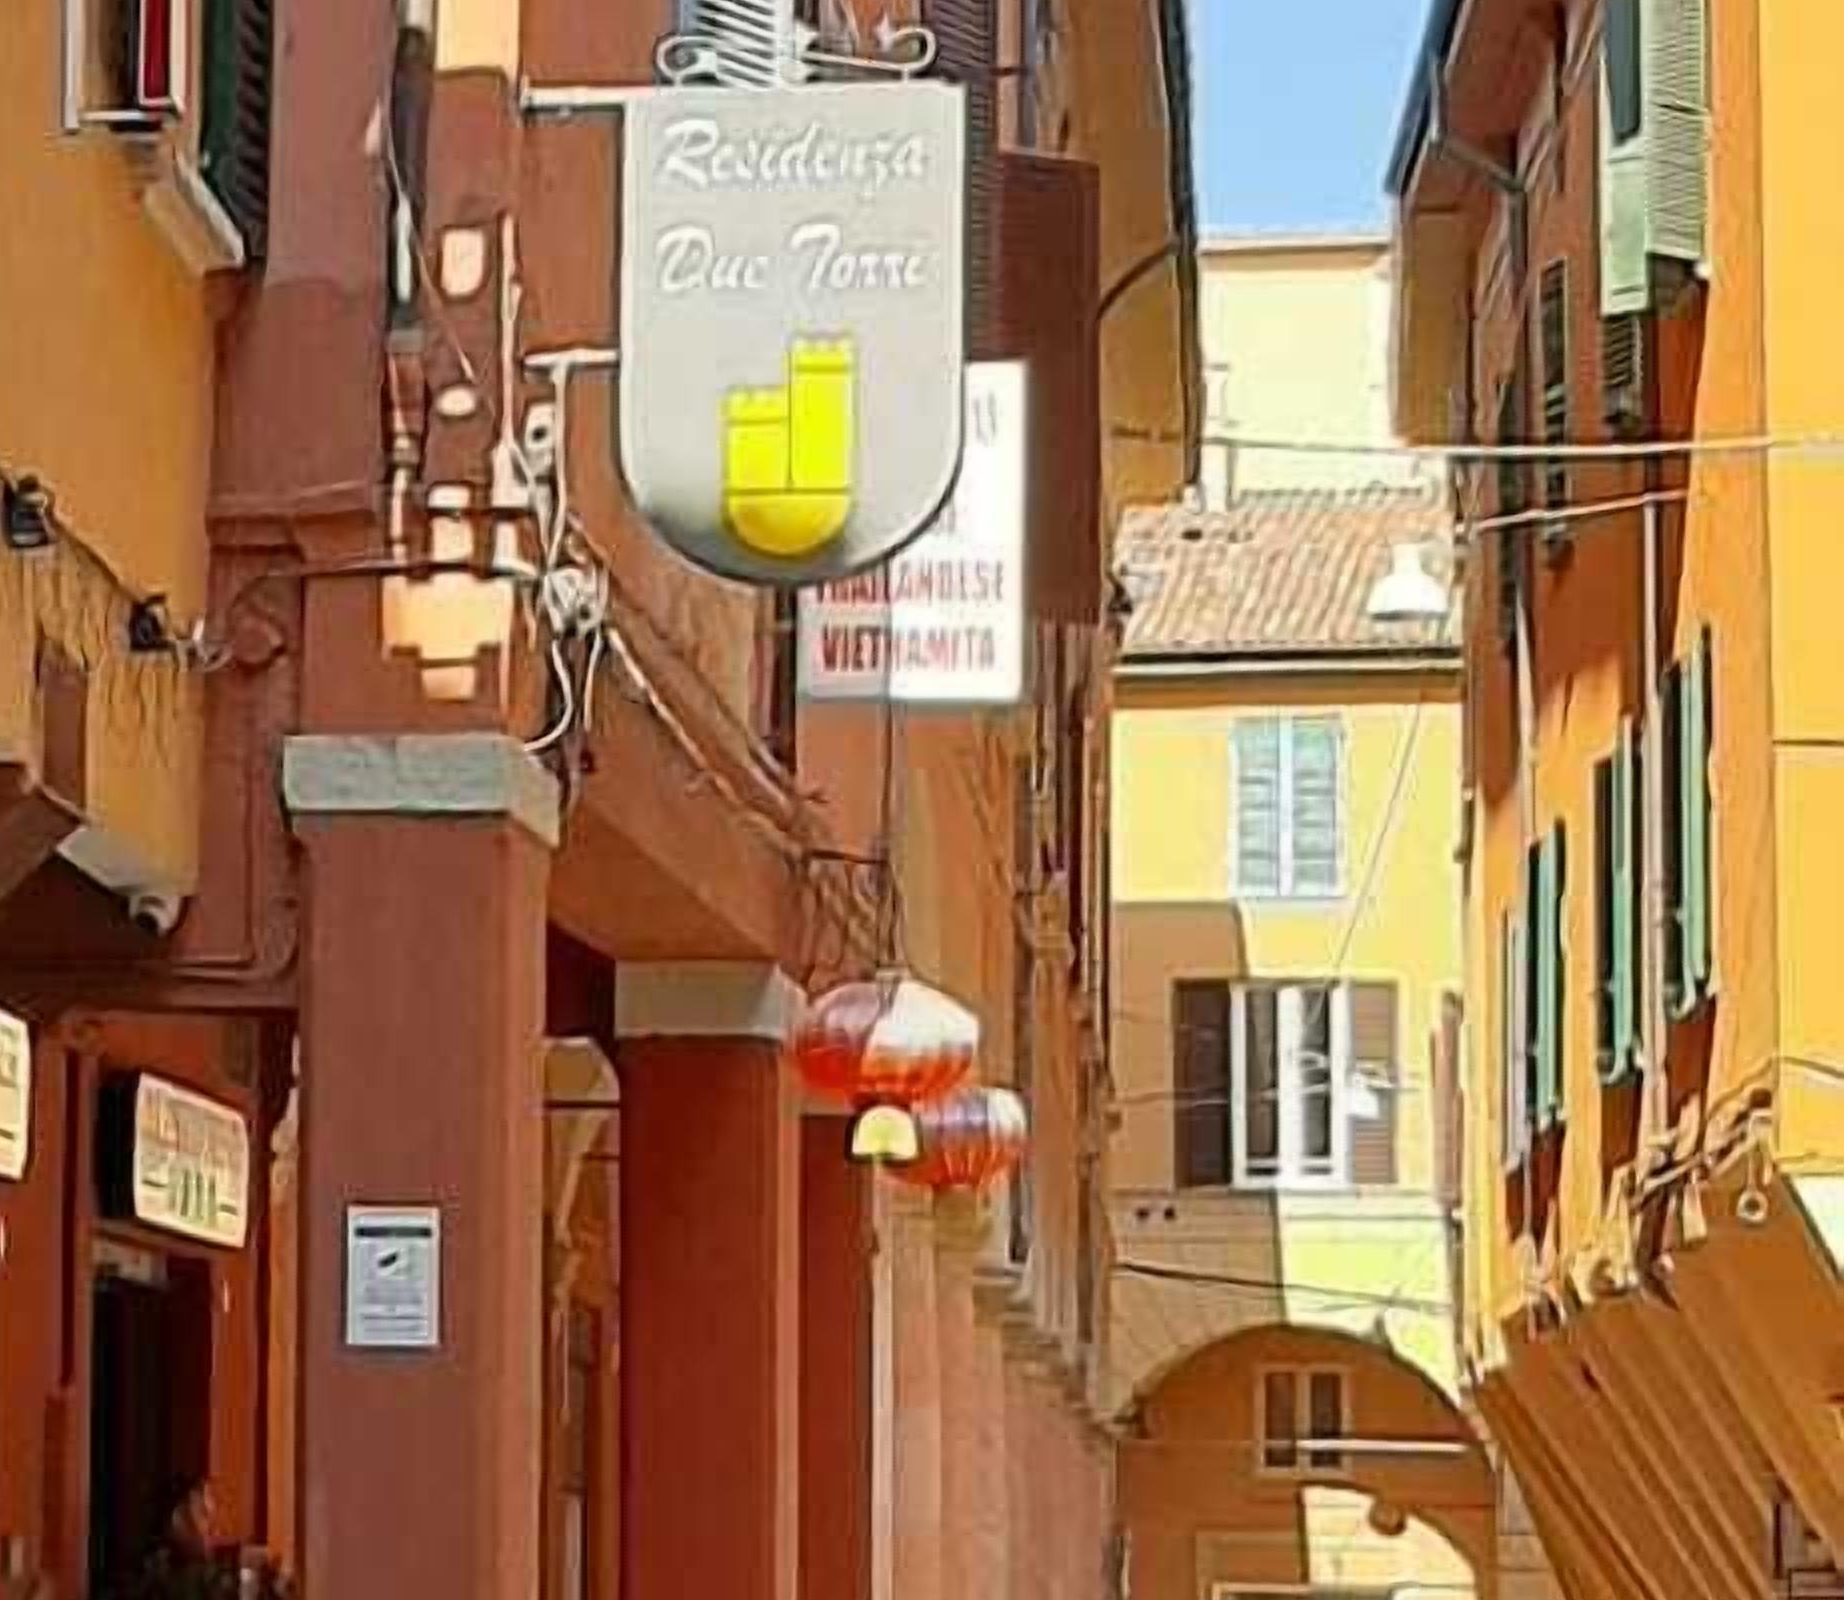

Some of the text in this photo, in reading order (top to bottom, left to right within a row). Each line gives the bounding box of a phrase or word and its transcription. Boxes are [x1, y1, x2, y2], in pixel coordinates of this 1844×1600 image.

[662, 117, 926, 198] Residenza
[655, 222, 769, 294] Due
[821, 625, 996, 672] VIETNAMITA
